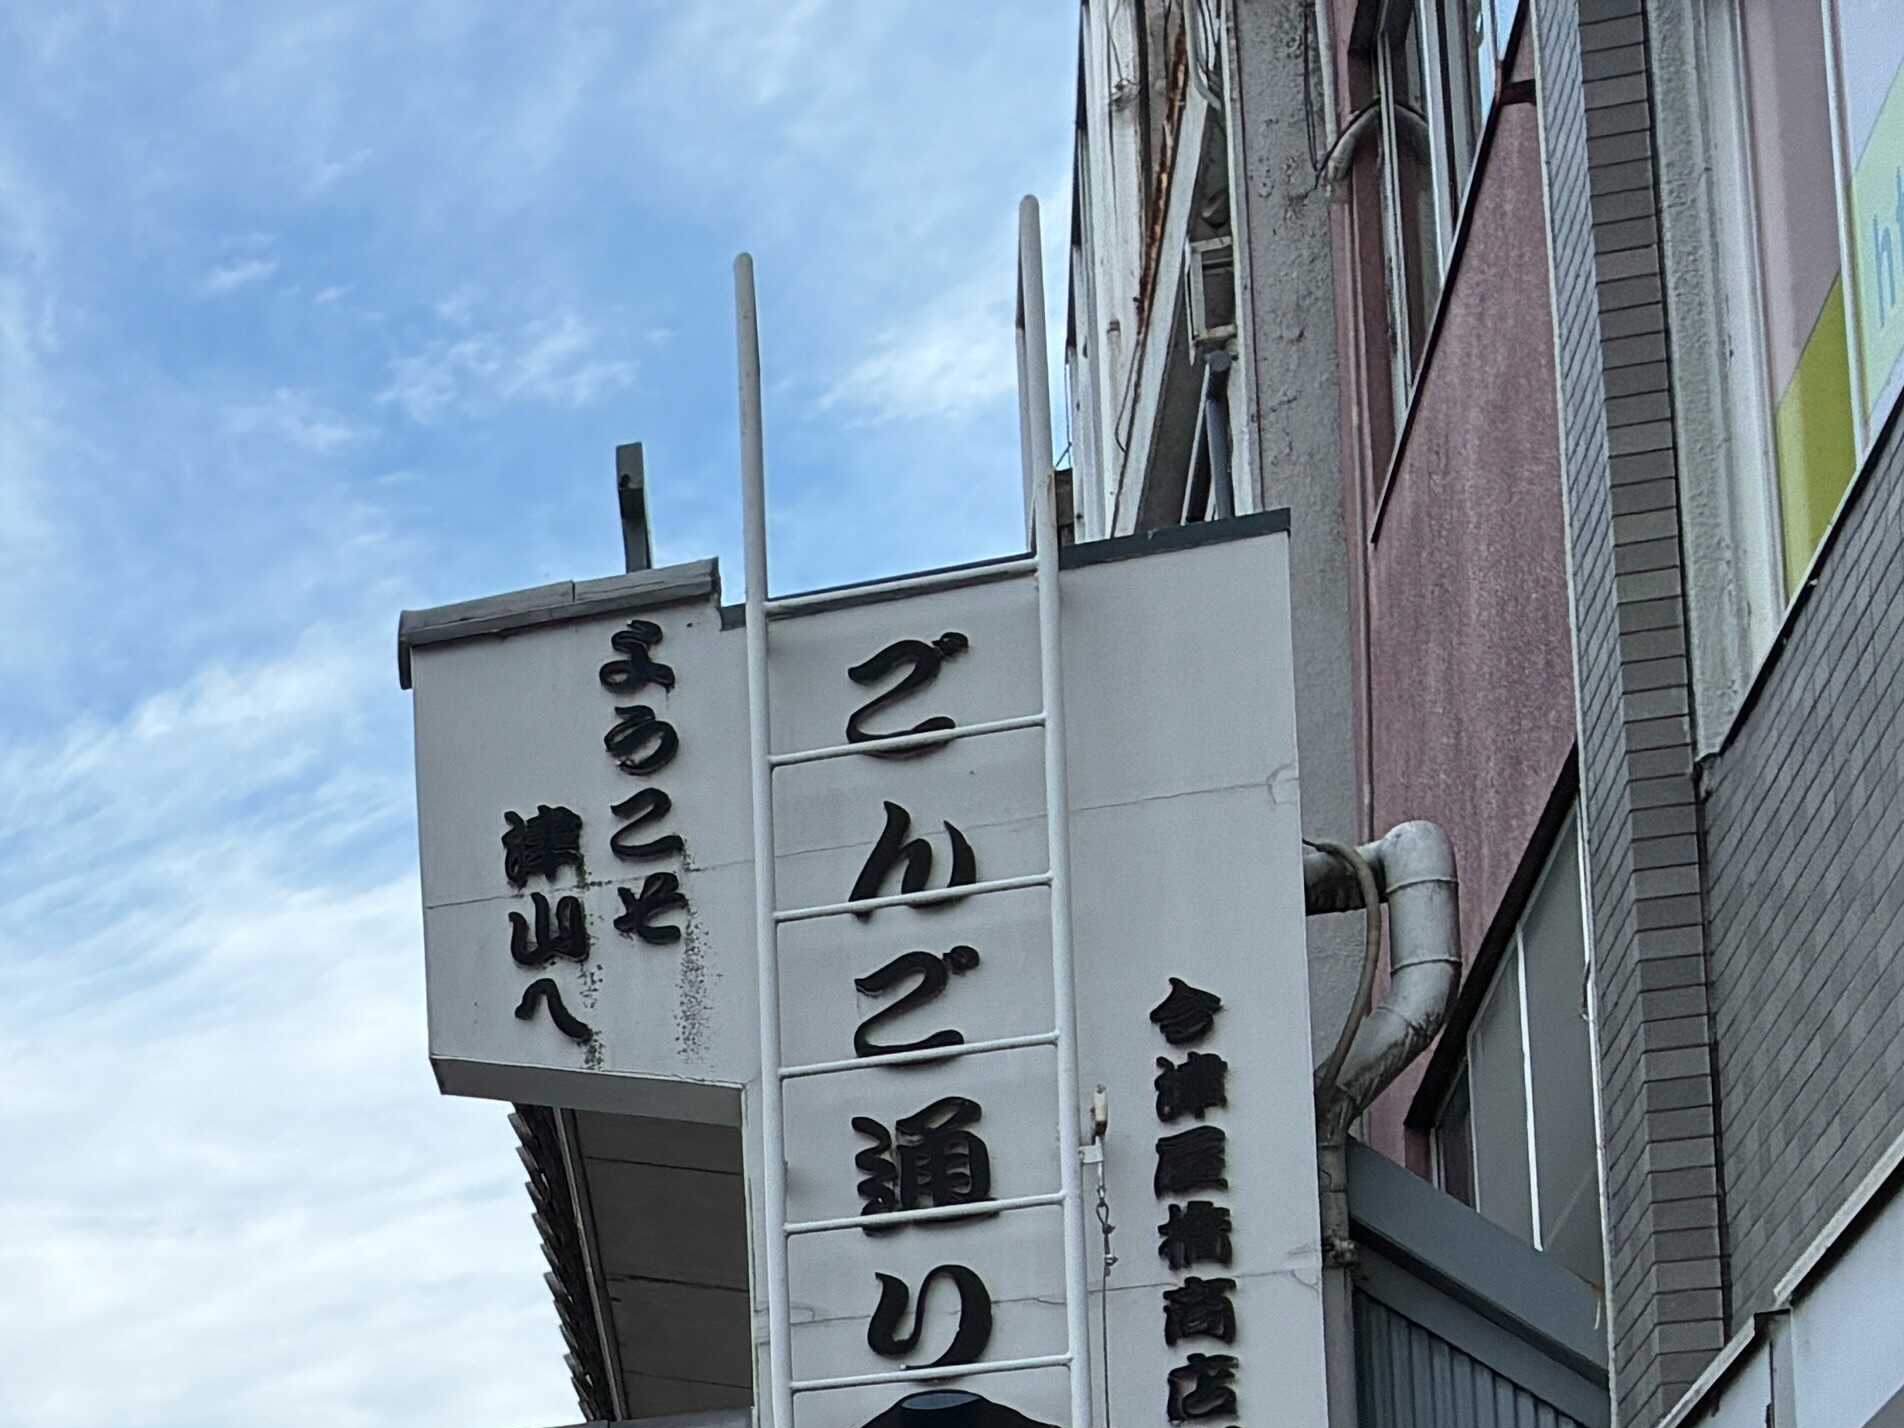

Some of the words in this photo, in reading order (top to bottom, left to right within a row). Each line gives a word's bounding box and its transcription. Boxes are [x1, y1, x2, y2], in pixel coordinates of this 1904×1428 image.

[502, 804, 592, 1046] 津山へ
[599, 619, 689, 945] ようこそ
[847, 630, 999, 1370] ごんご通り
